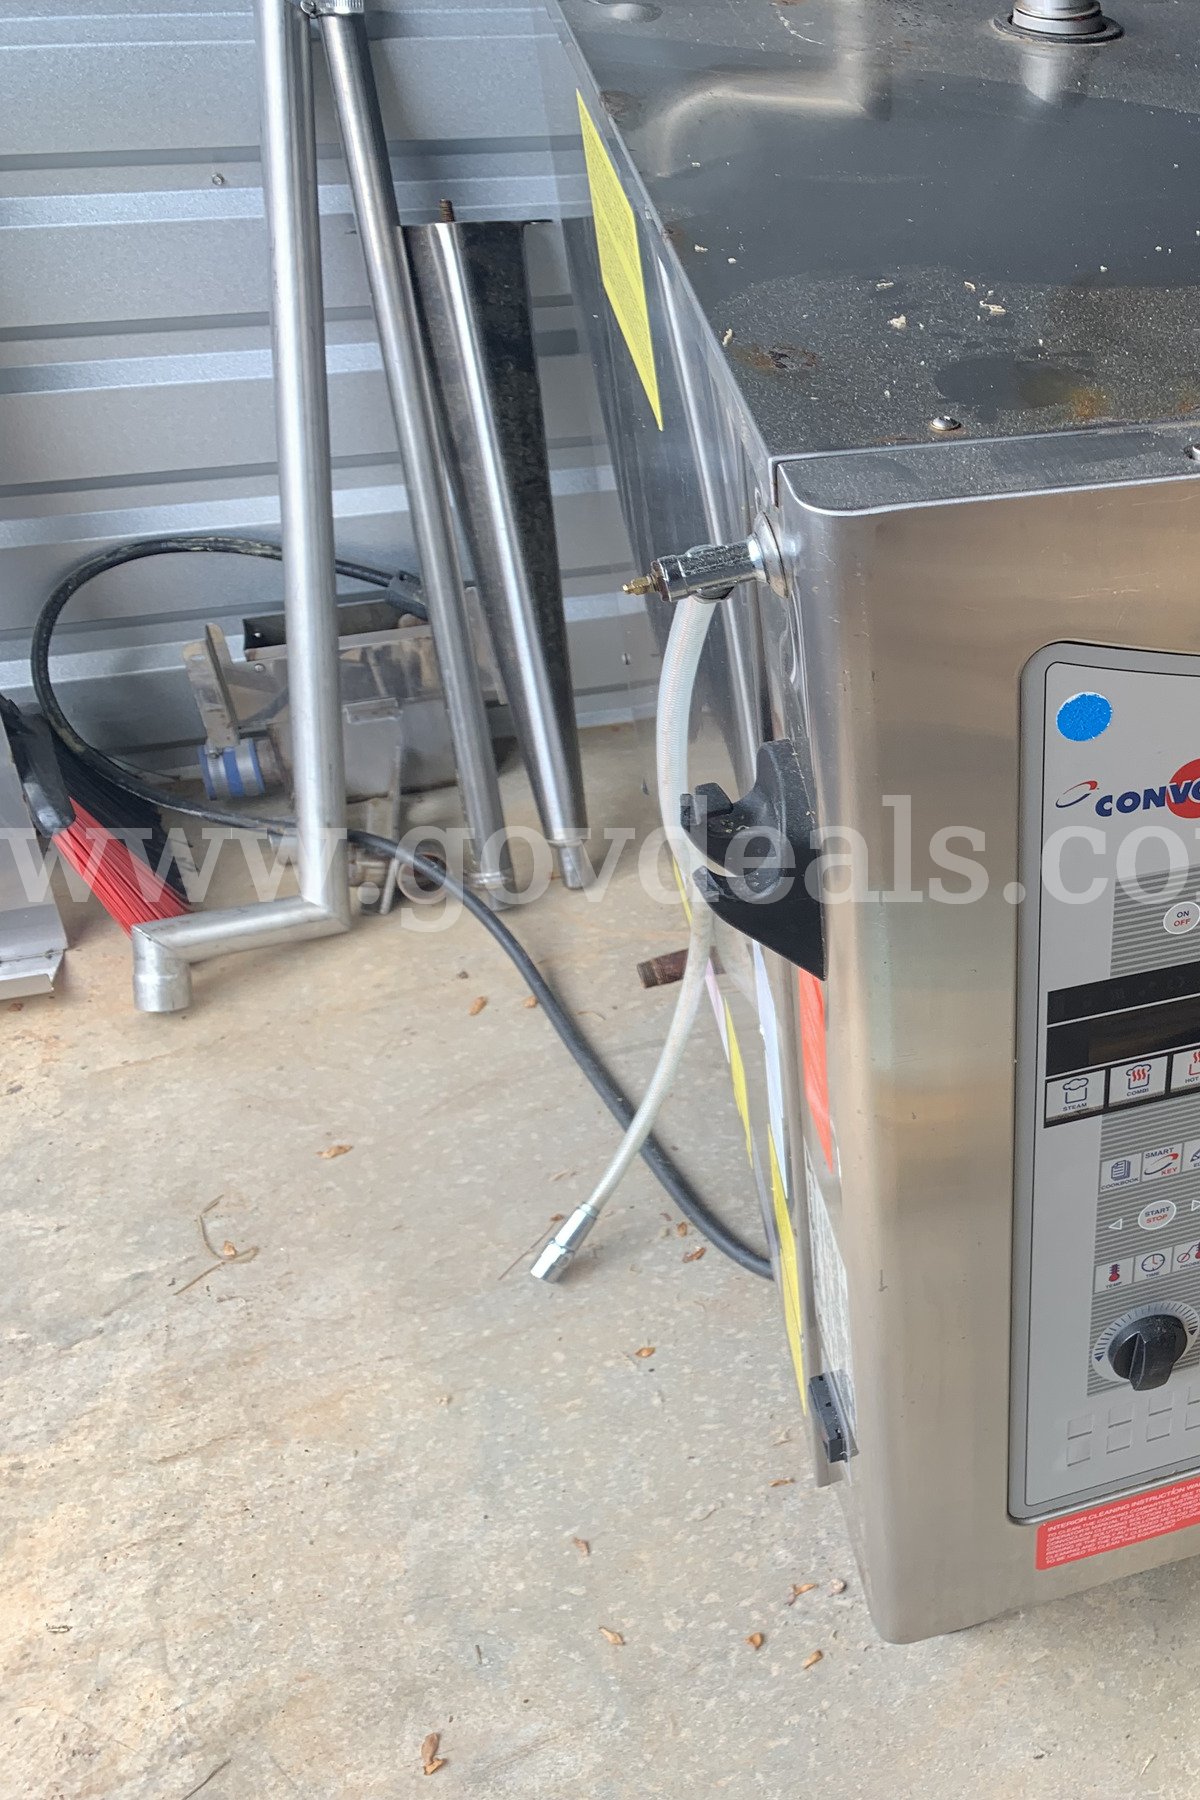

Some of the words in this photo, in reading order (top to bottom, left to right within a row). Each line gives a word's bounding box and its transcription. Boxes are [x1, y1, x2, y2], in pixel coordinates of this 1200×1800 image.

[1176, 910, 1190, 919] ON
[1173, 918, 1191, 927] OFF
[1185, 1076, 1199, 1084] HOT
[1126, 1088, 1149, 1097] COMBI
[1062, 1102, 1087, 1112] STEAM
[1144, 1147, 1174, 1159] SMART
[1161, 1167, 1178, 1176] KEY
[1101, 1177, 1139, 1190] COOKBOOK
[1144, 1206, 1171, 1218] START
[1146, 1214, 1168, 1224] STOP
[1047, 1515, 1087, 1532] INTERIOR
[1088, 1503, 1129, 1520] CLEANING
[1131, 1486, 1185, 1507] INSTRUCTION
